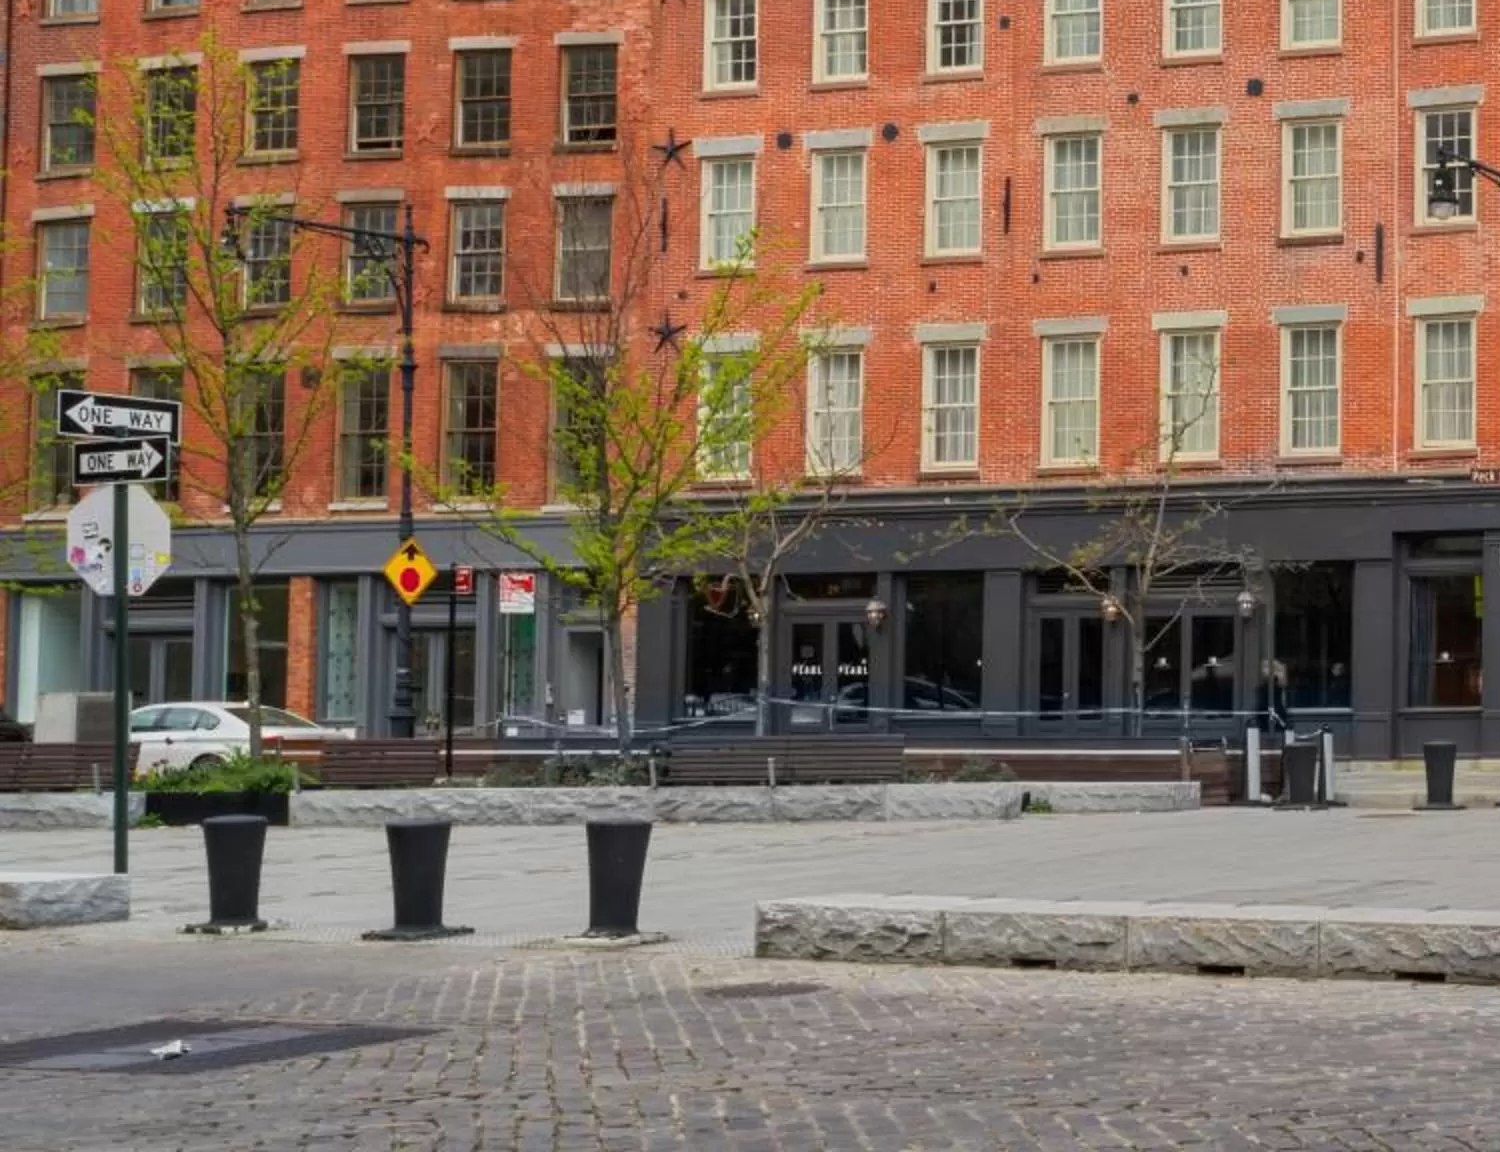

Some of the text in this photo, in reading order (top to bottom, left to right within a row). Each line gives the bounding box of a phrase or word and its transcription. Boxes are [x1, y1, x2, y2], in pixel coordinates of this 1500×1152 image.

[79, 406, 164, 428] ONE WAY
[87, 451, 154, 470] ONE WAY
